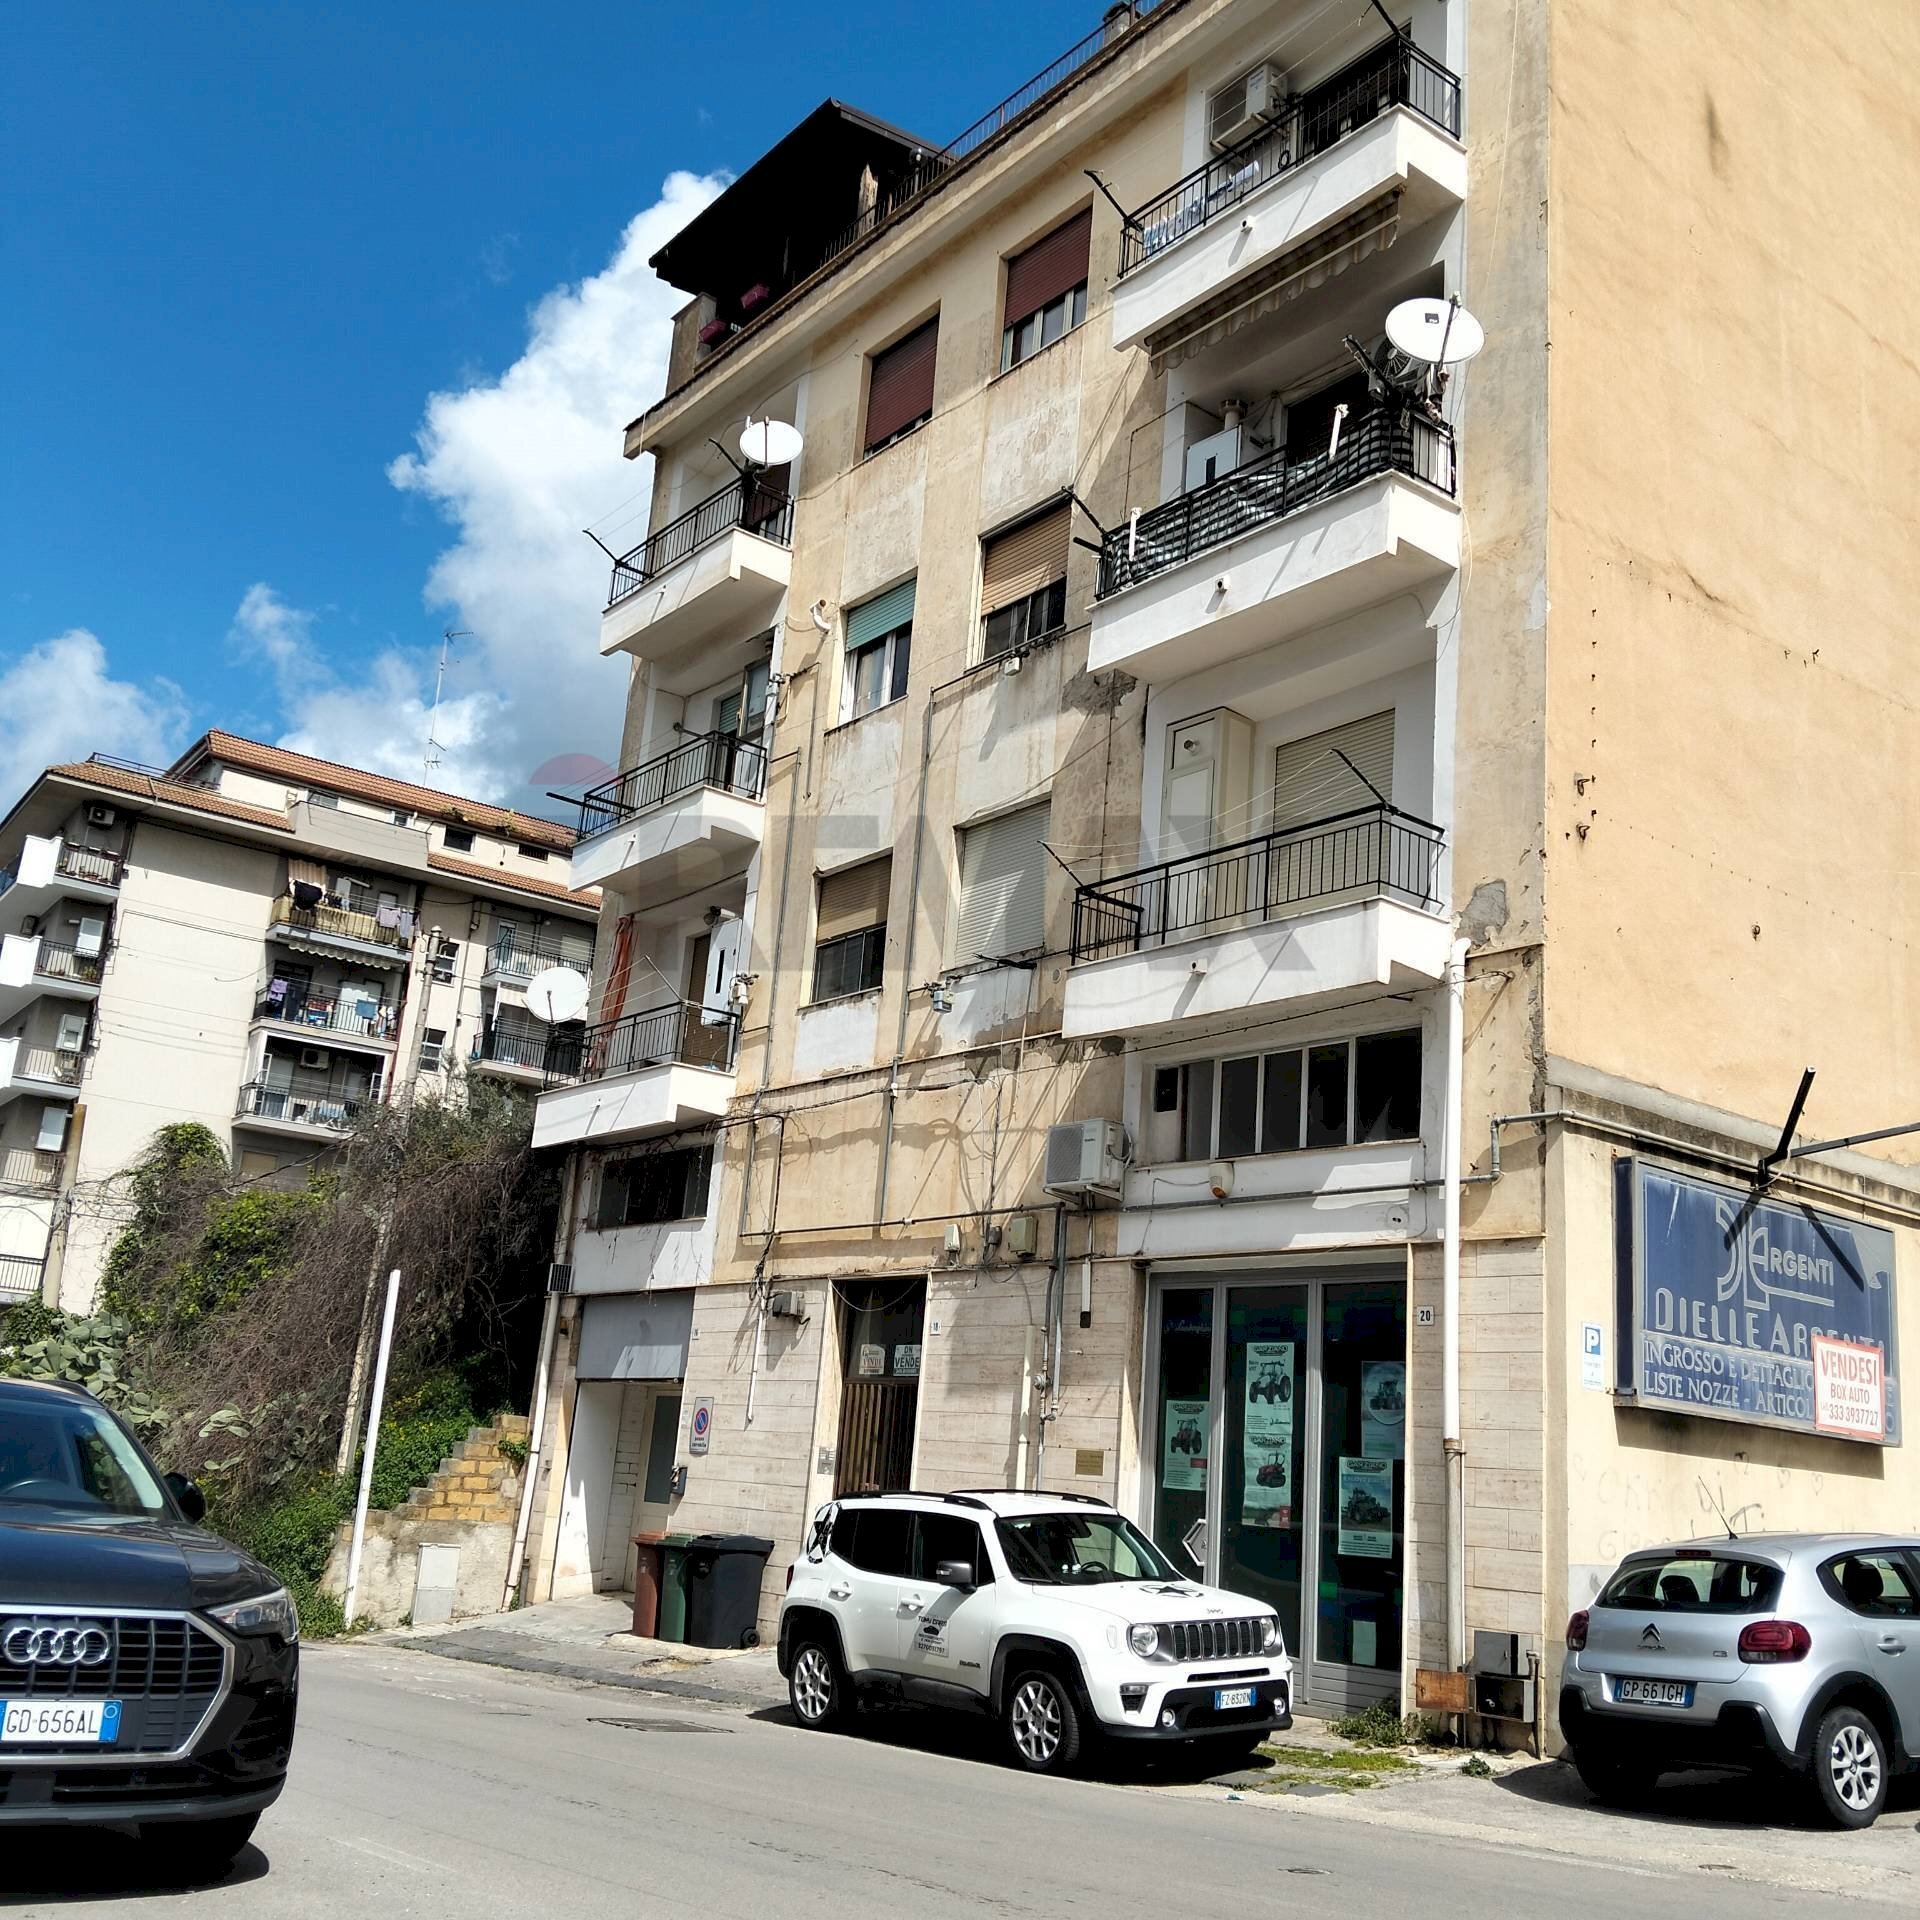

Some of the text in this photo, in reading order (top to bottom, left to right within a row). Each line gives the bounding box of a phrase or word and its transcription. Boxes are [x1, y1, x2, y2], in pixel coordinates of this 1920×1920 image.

[1420, 1310, 1431, 1321] 20
[1655, 1287, 1762, 1350] DIELLE
[895, 1356, 920, 1368] VENDE
[1644, 1340, 1814, 1393] INGROSSO E DETTAGLIO
[1821, 1349, 1877, 1387] VENDESI
[1644, 1370, 1683, 1398] LISTE
[1688, 1377, 1740, 1408] NOZZE
[1755, 1390, 1814, 1420] ARTICOL
[1830, 1383, 1847, 1401] BOX
[1849, 1386, 1870, 1405] AUTO
